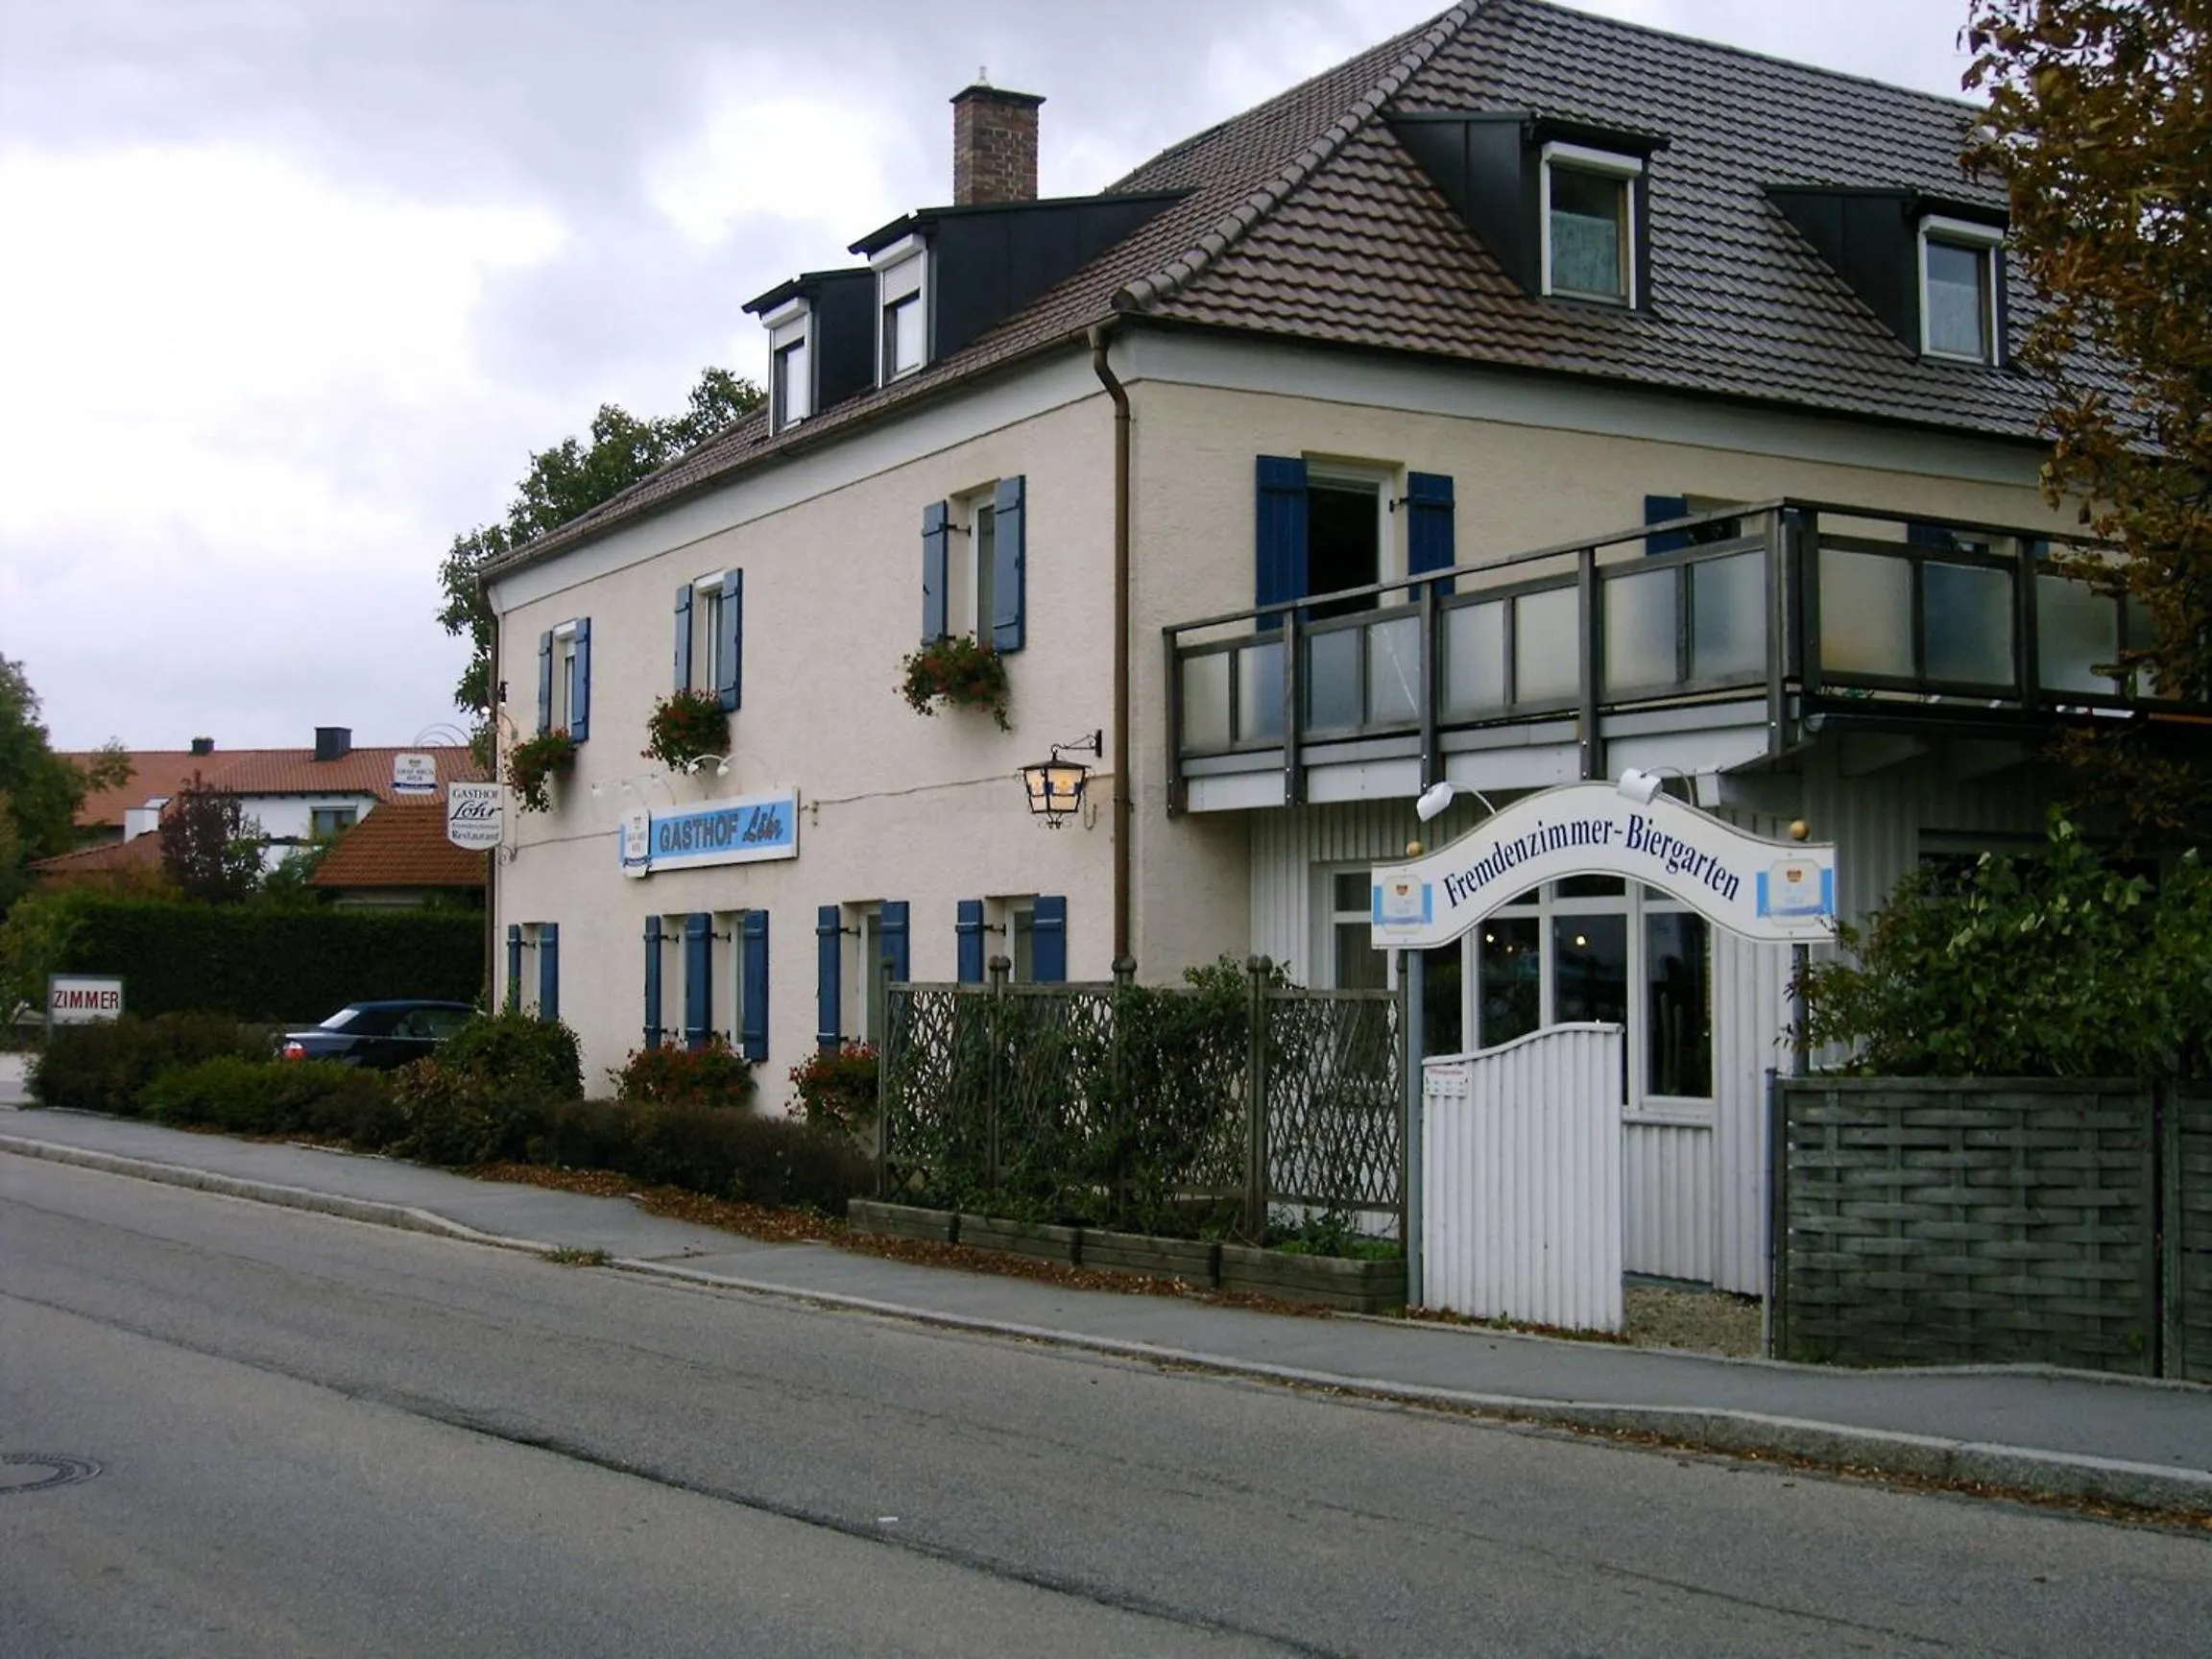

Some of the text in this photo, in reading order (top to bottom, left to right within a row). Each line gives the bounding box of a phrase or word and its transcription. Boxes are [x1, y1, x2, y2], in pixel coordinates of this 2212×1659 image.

[452, 789, 498, 800] GASTHOF
[660, 814, 738, 853] GASTHOF
[1443, 813, 1741, 909] Fremdenzimmer-Biergarten
[54, 990, 119, 1009] ZIMMER
